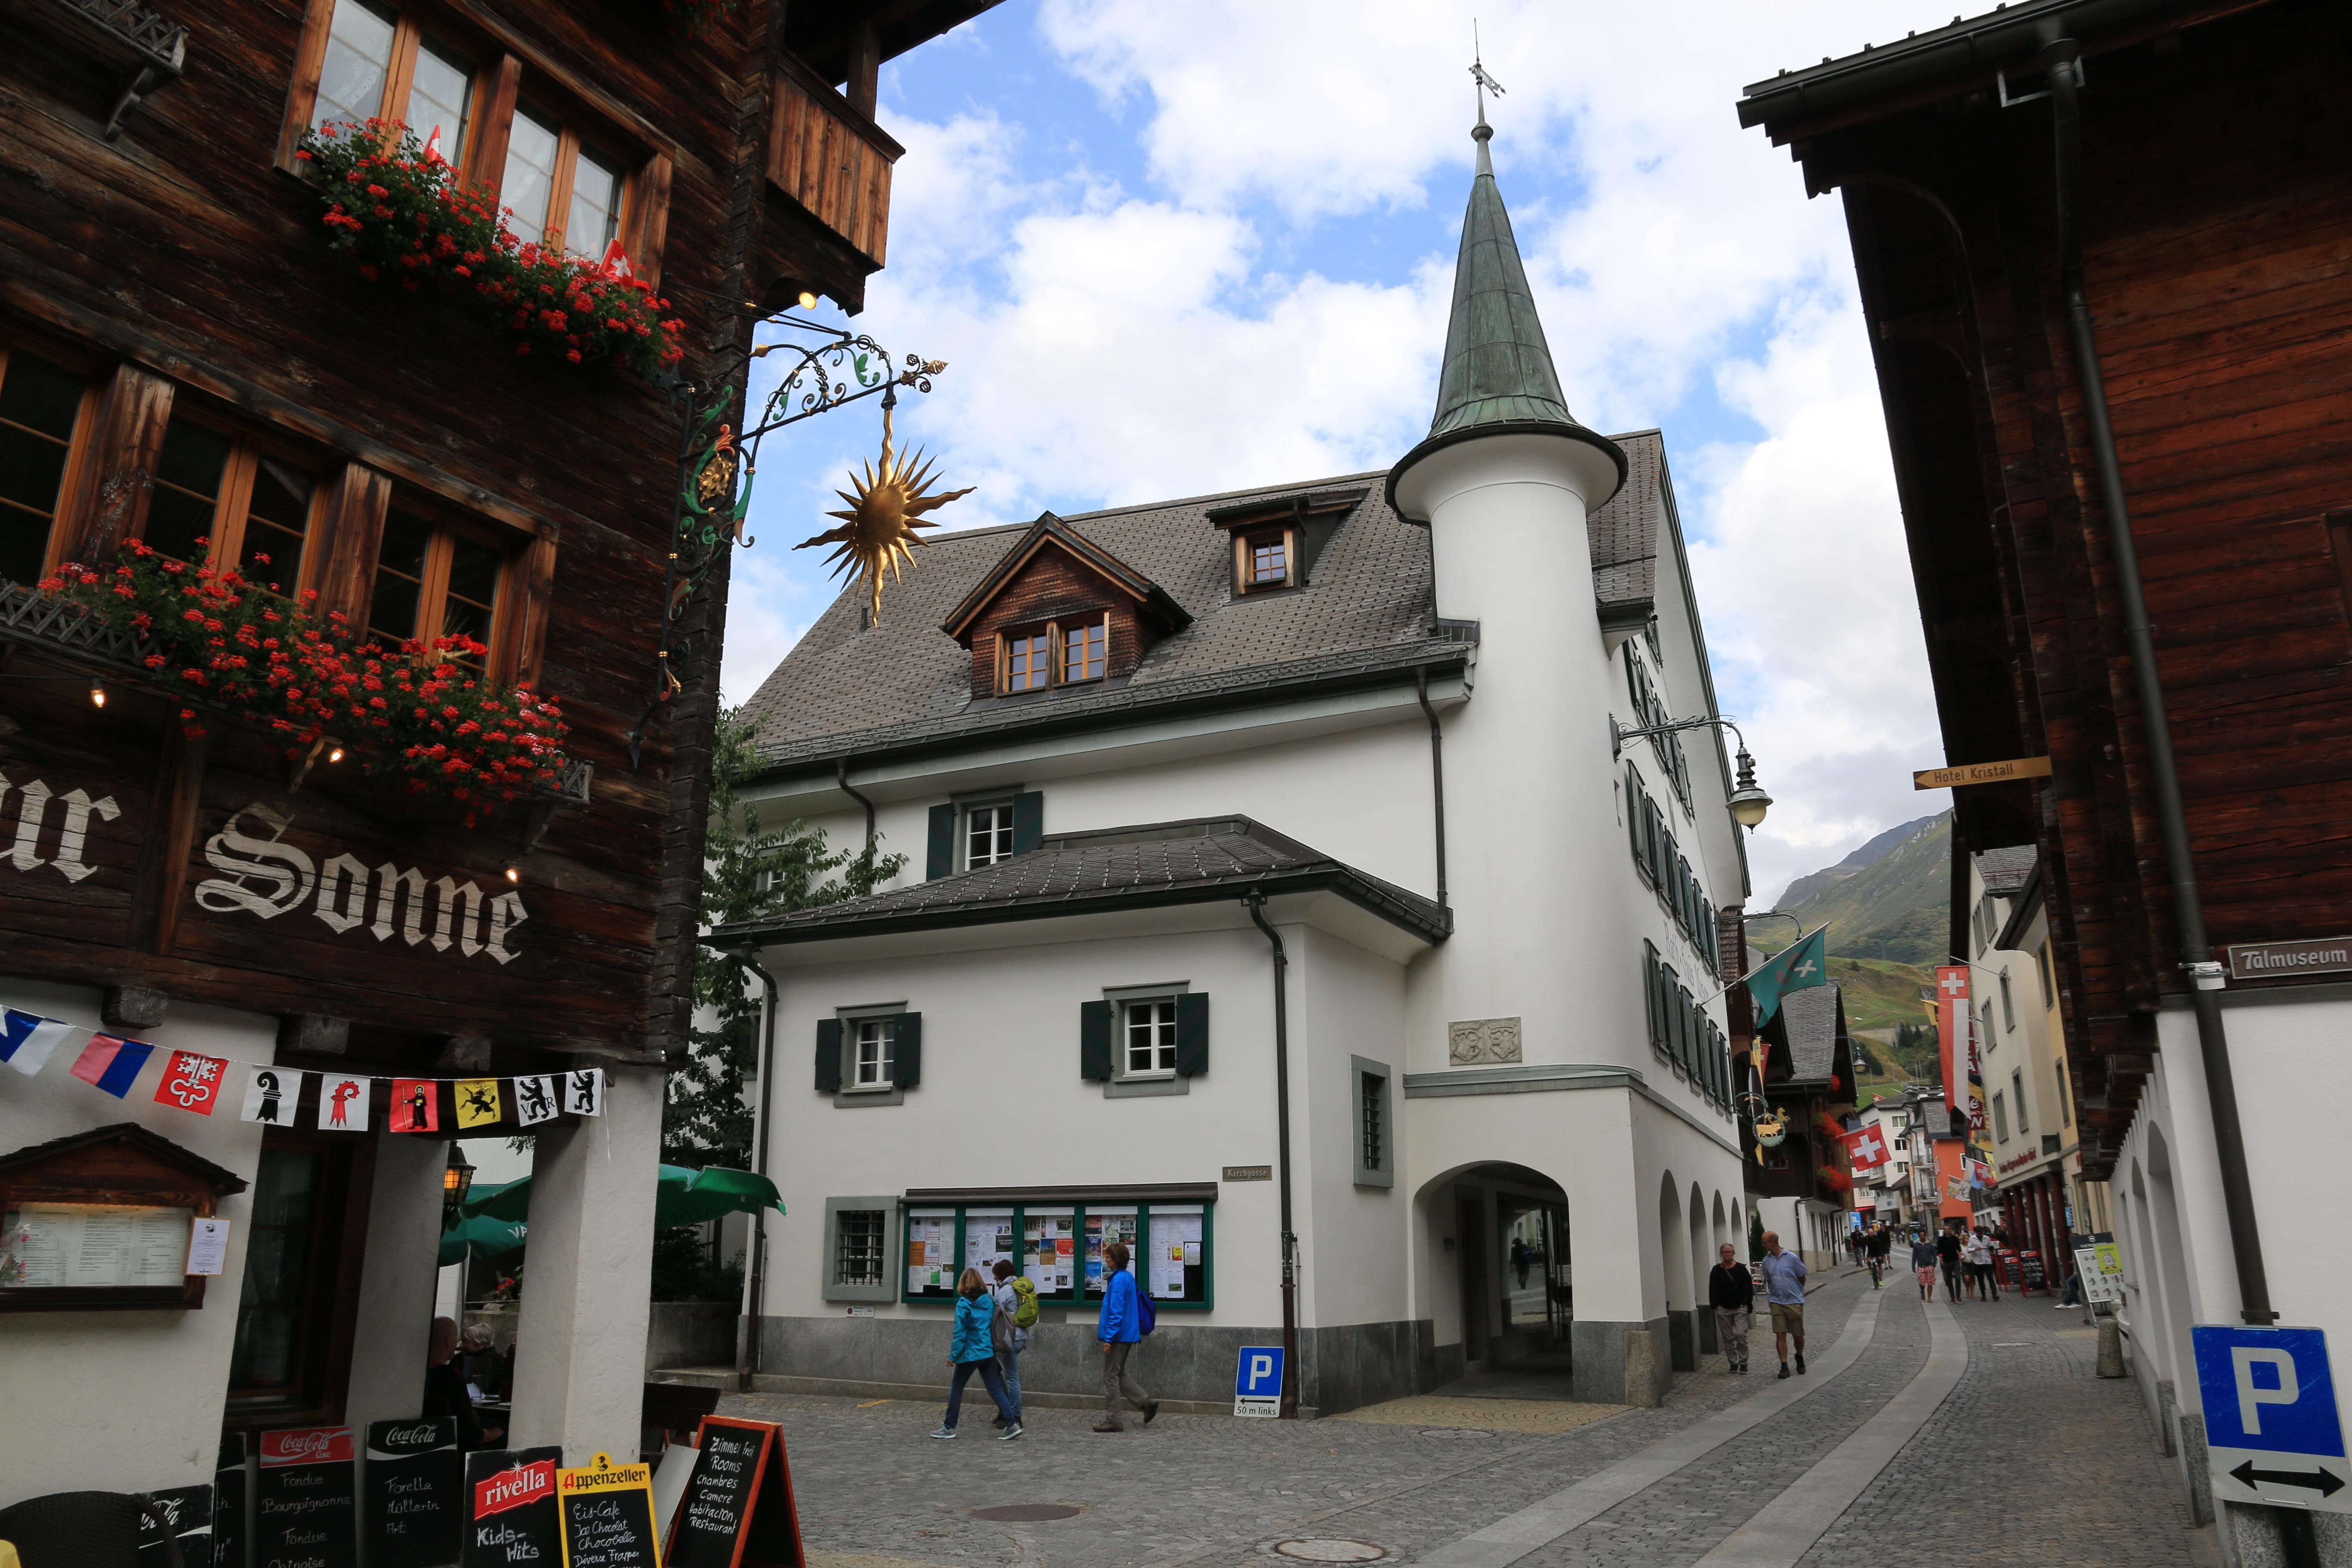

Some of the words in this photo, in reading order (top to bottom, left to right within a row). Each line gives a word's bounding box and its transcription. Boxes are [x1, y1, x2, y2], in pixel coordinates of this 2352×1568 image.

[1934, 769, 1964, 783] Hotel
[1970, 763, 2013, 779] Kristall
[195, 802, 529, 965] Sonne
[2241, 949, 2347, 970] Talmuseum
[521, 1102, 530, 1114] V
[546, 1097, 555, 1109] R
[1228, 1169, 1267, 1179] Kirchgasse
[1249, 1355, 1272, 1390] P
[2231, 1346, 2300, 1435] P
[1259, 1407, 1276, 1415] links
[280, 1432, 331, 1453] Coca-Cola
[386, 1424, 439, 1446] Coca-Cola
[711, 1455, 742, 1473] Rooms
[279, 1472, 324, 1487] Fondue
[385, 1476, 433, 1494] Forelle
[486, 1468, 545, 1506] rivella
[563, 1469, 646, 1490] Appenzeller
[697, 1474, 739, 1488] Chambres
[261, 1496, 351, 1514] Bourguignonne
[700, 1489, 733, 1504] Camere
[387, 1499, 440, 1513] Müllerin
[387, 1521, 407, 1534] Art
[575, 1524, 591, 1538] Ice
[592, 1519, 628, 1534] Chocolat
[689, 1516, 737, 1534] Restaurant
[282, 1528, 330, 1546] Fondue
[477, 1523, 527, 1547] Kids-
[579, 1531, 637, 1550] Chocobello
[506, 1541, 539, 1562] Hits
[573, 1554, 606, 1567] Diverse
